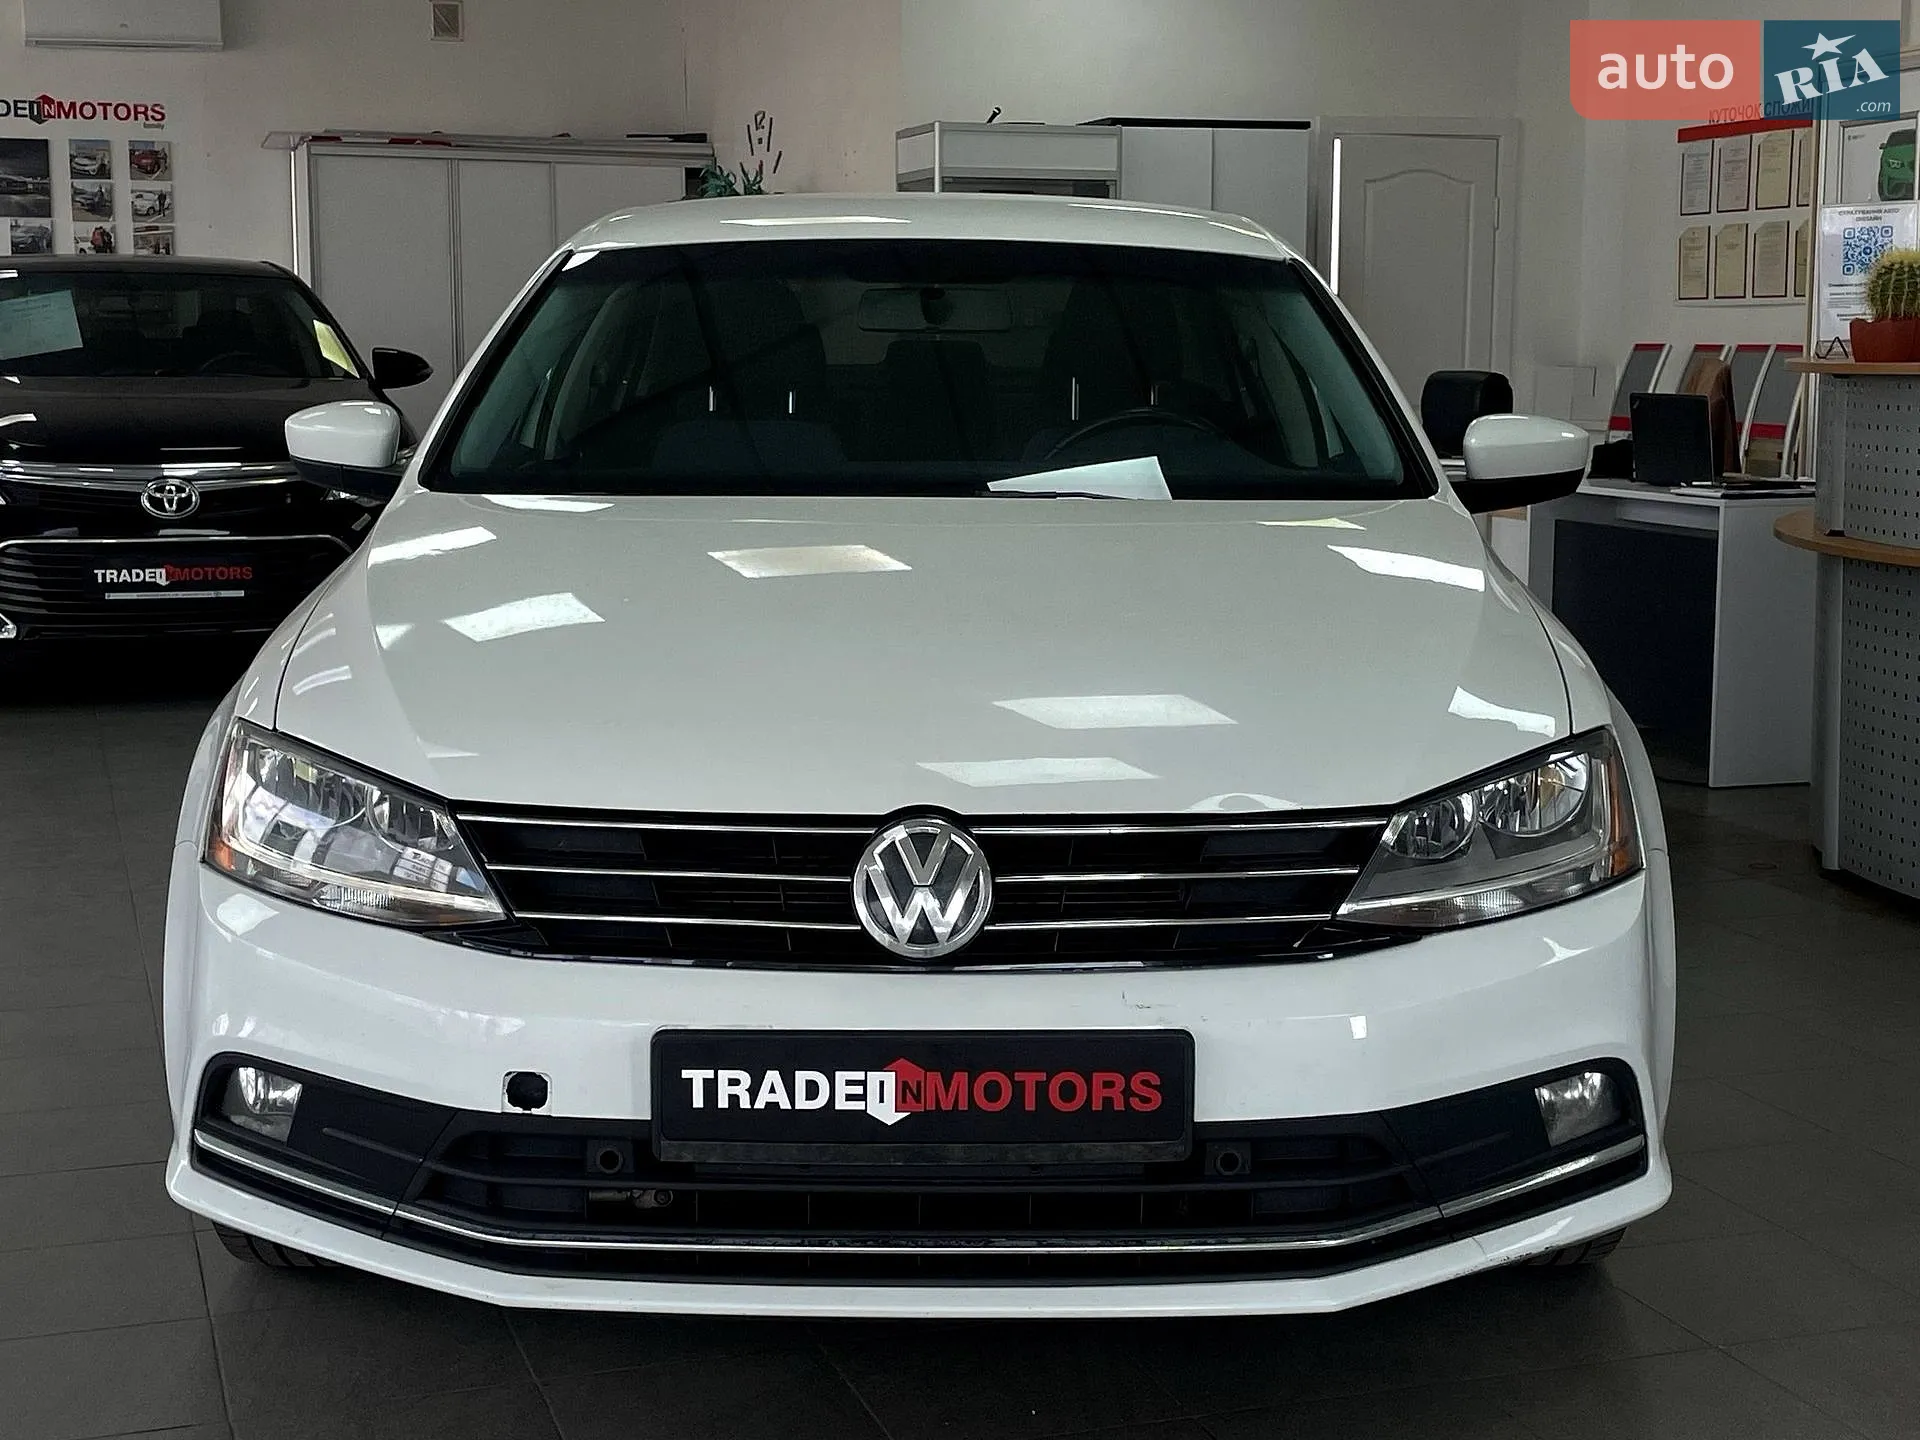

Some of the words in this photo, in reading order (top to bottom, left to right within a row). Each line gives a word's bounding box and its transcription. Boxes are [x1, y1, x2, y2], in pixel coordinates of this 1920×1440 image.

[57, 101, 166, 122] MOTORS
[1708, 102, 1761, 124] КУТОЧОК
[926, 1071, 1163, 1112] MOTORS
